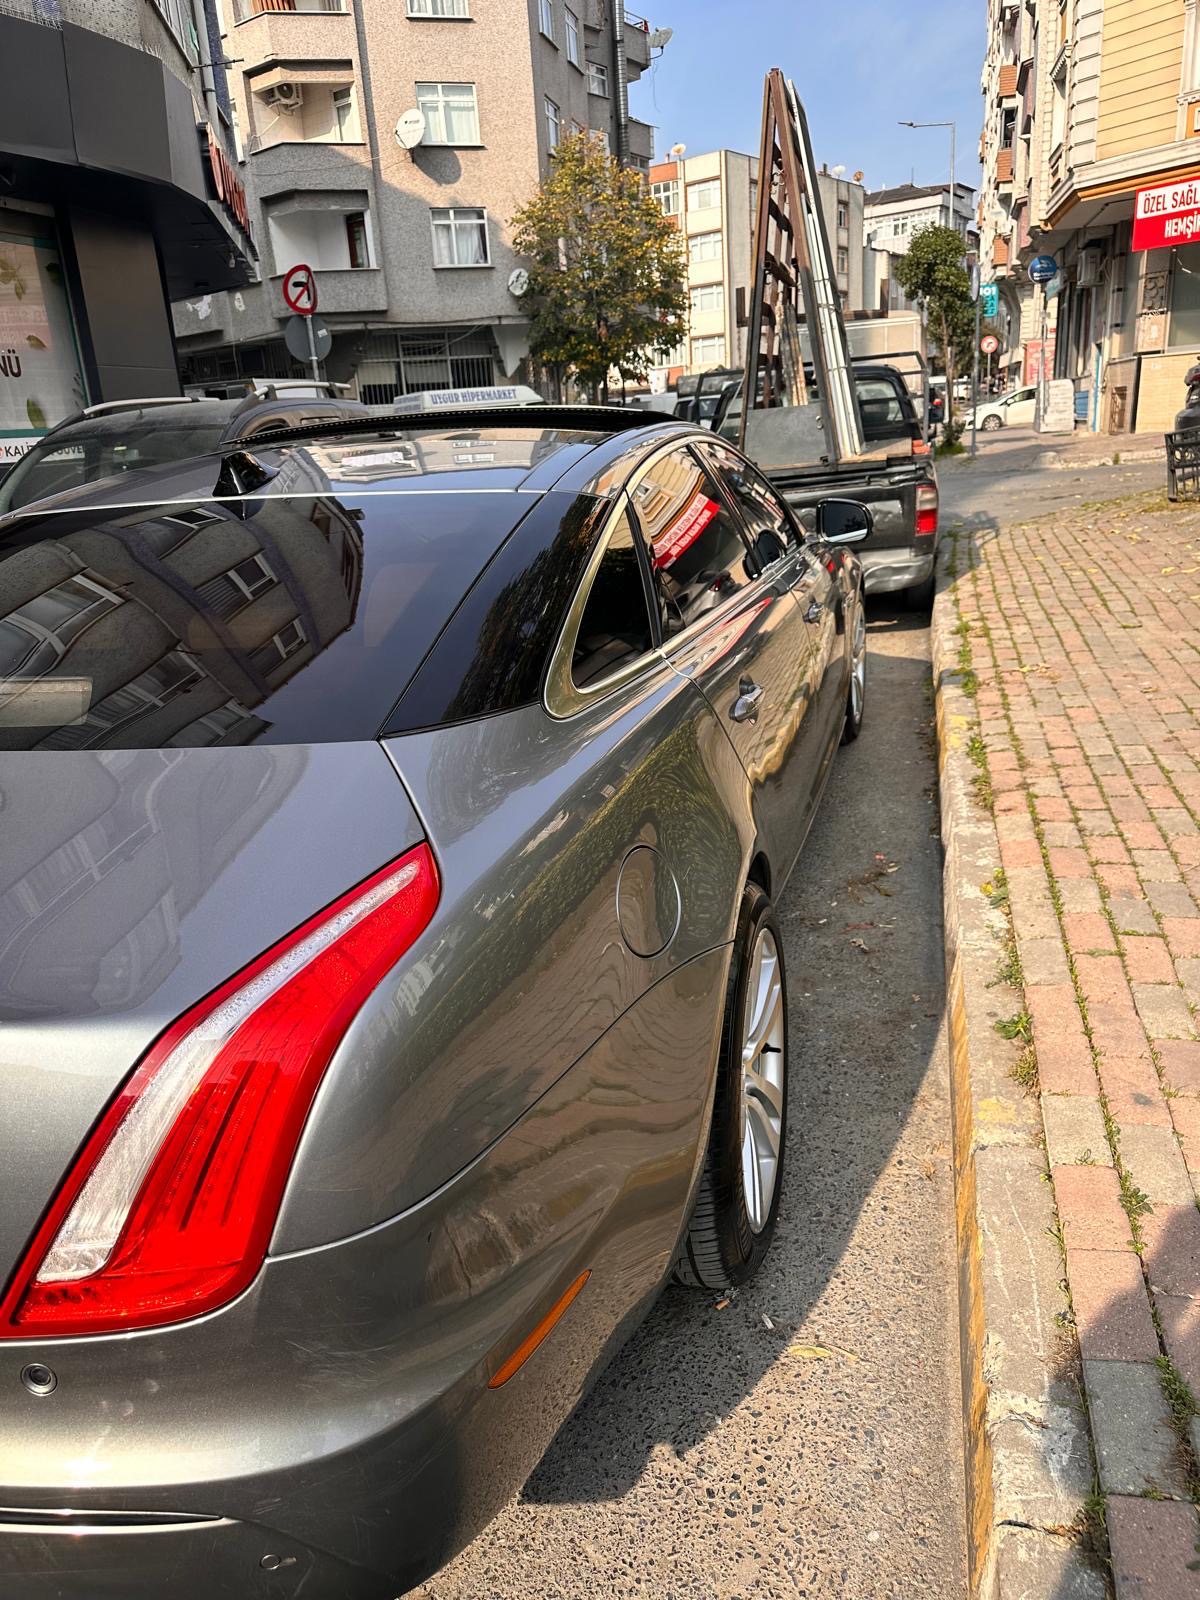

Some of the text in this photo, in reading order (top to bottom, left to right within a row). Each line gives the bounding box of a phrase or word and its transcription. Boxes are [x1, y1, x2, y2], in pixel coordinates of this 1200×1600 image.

[1143, 192, 1168, 214] ÖZEL
[430, 392, 460, 405] UYGUR
[461, 388, 517, 403] HİPERMARKET
